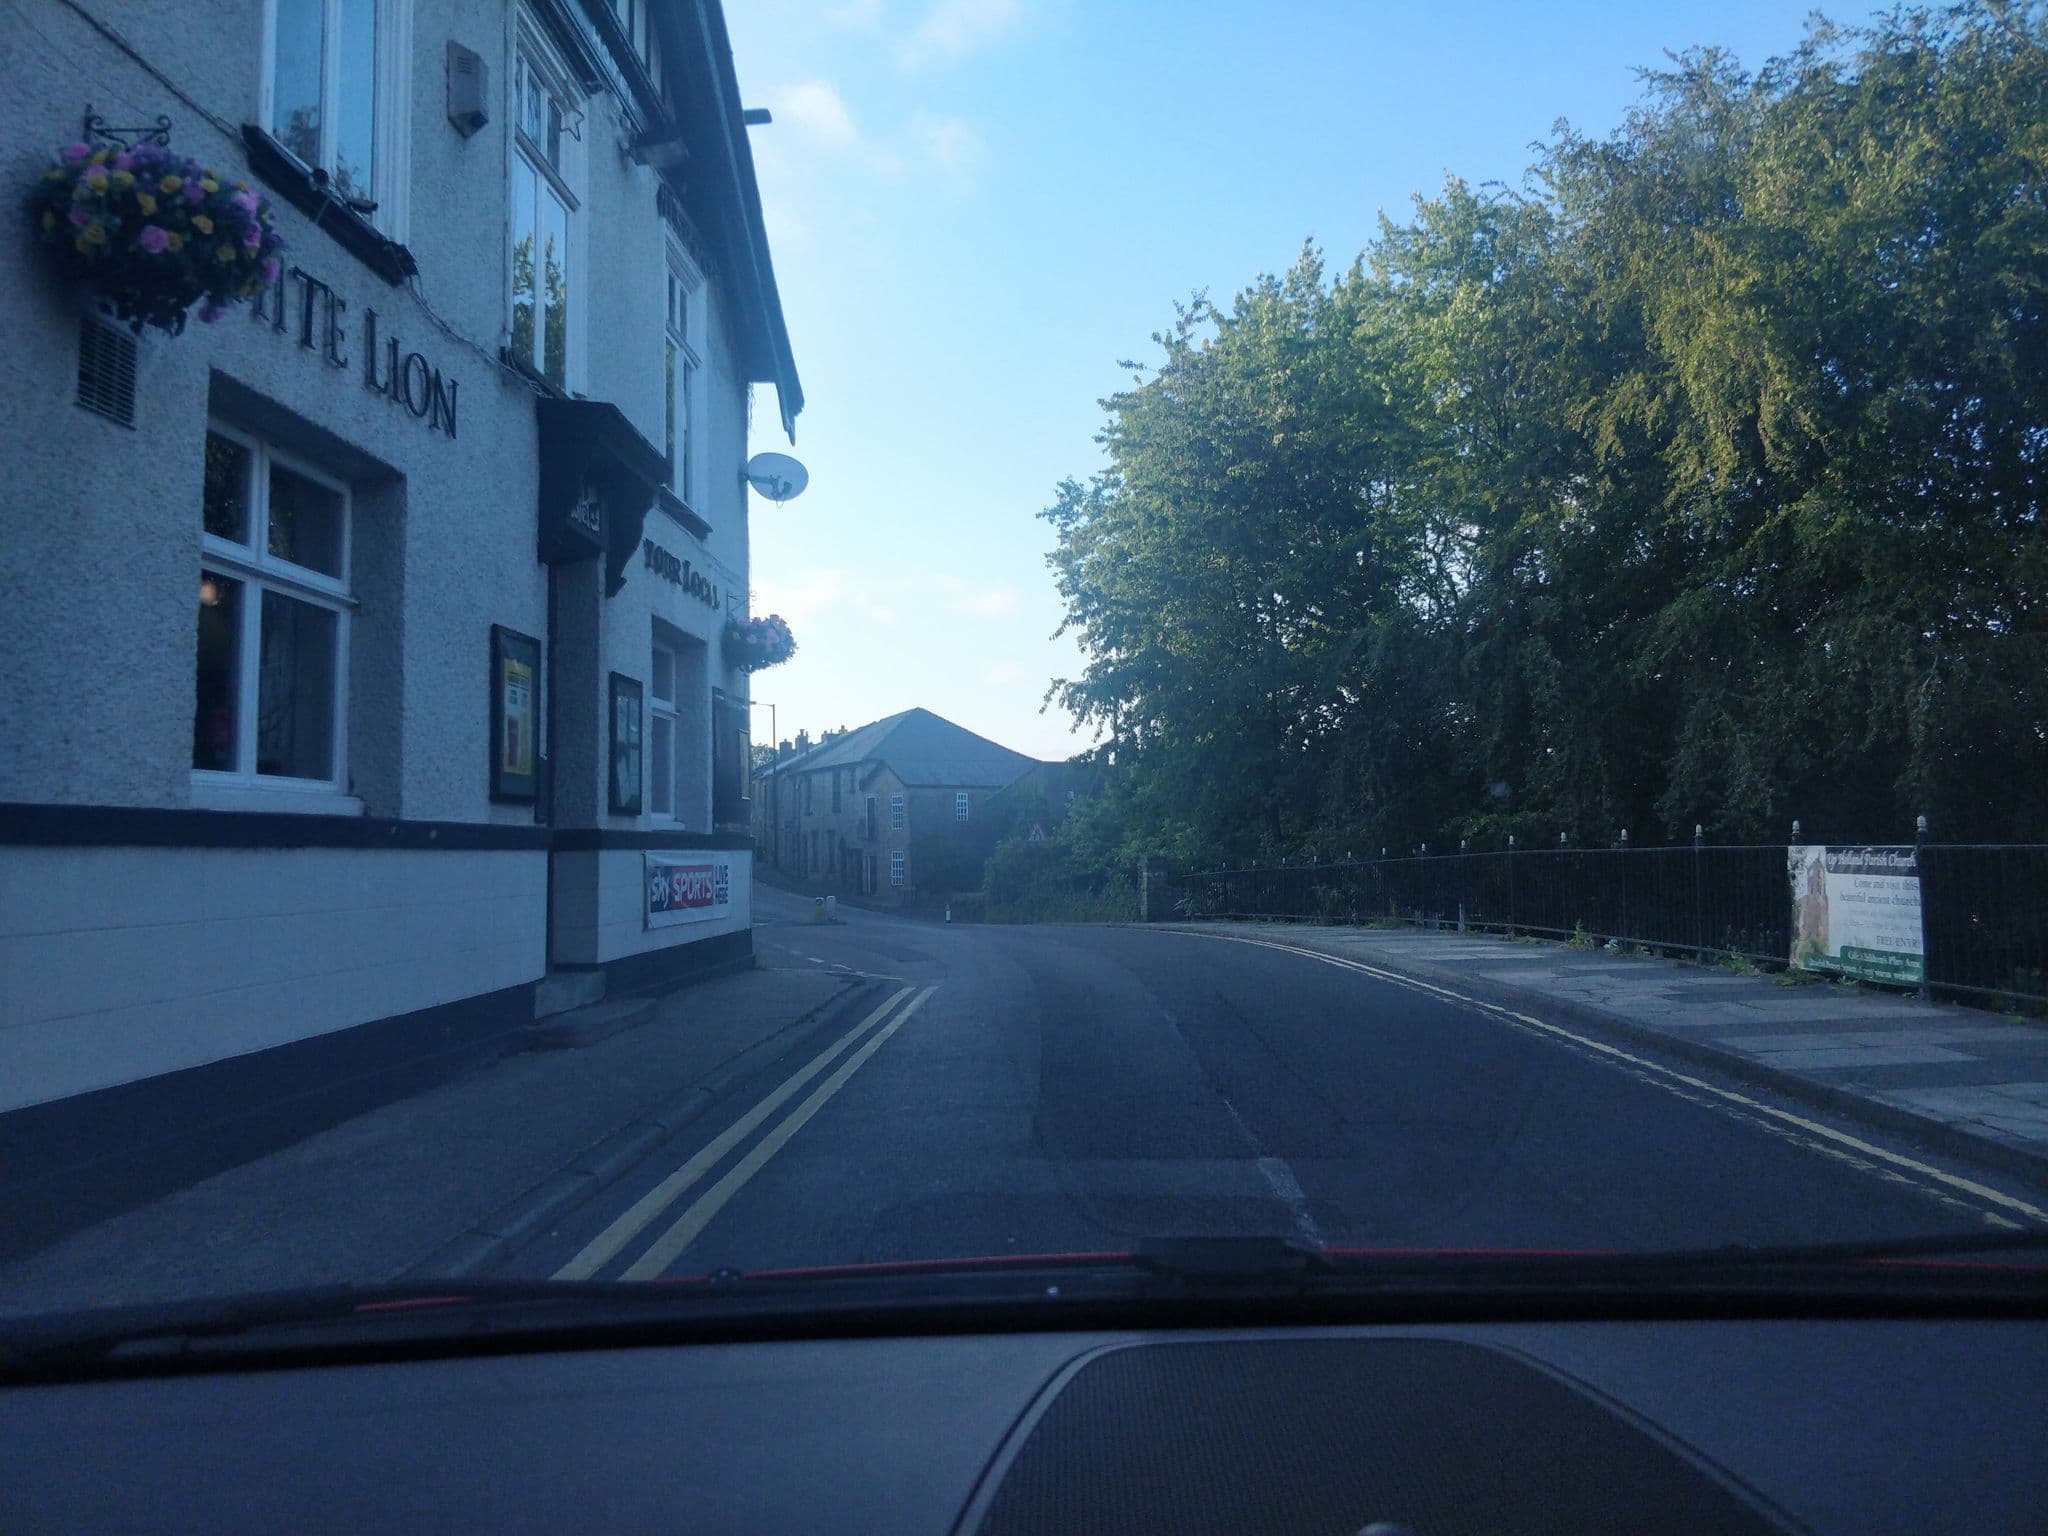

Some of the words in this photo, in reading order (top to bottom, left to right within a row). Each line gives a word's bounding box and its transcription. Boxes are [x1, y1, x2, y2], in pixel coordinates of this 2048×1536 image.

[365, 306, 460, 439] LION
[642, 537, 682, 585] YOUR
[1864, 848, 1888, 866] Parish
[1888, 851, 1917, 867] Church
[673, 871, 713, 902] SPORTS
[1892, 894, 1920, 906] church
